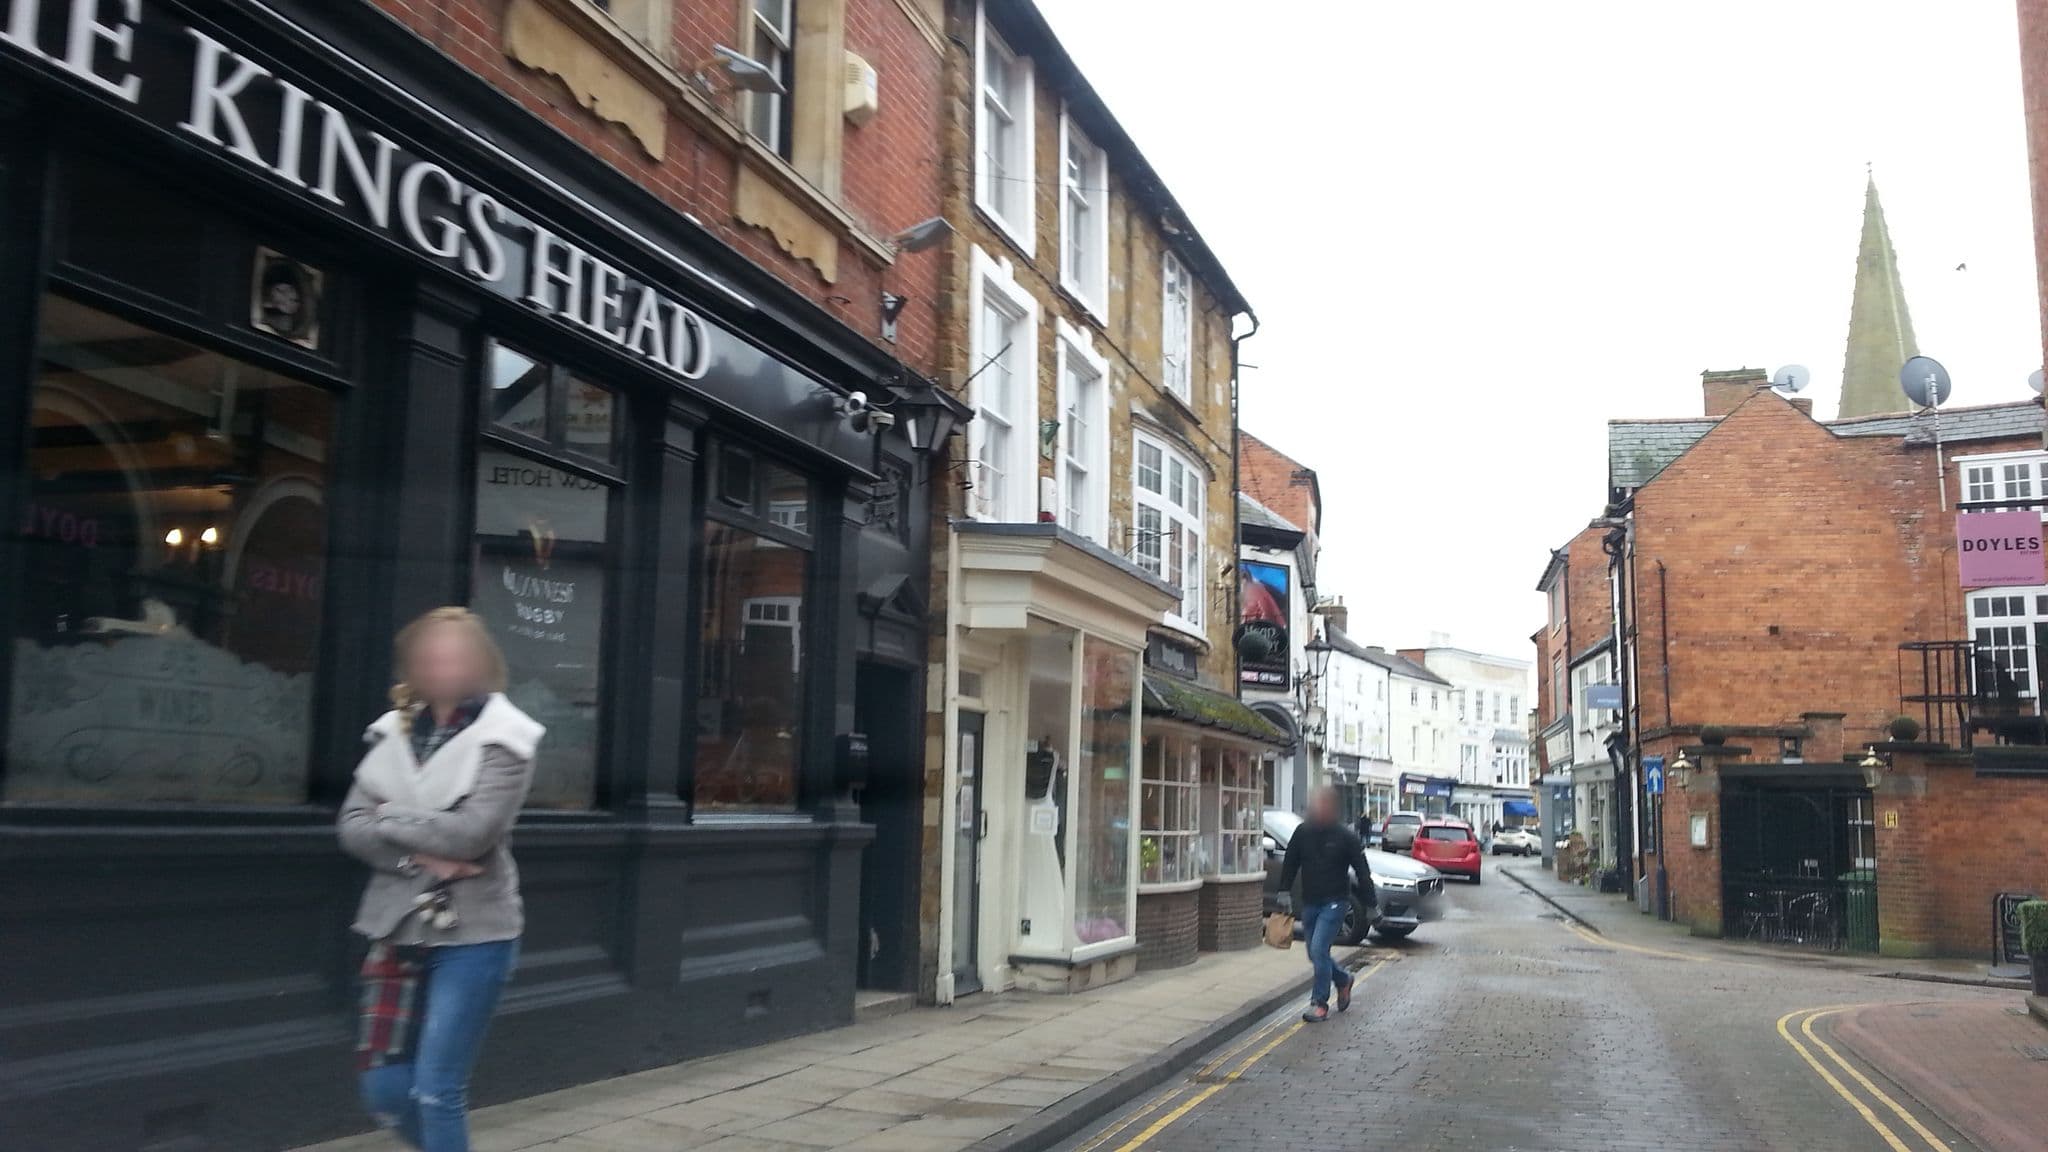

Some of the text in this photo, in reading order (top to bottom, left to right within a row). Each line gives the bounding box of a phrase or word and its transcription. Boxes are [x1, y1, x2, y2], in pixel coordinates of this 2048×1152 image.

[176, 26, 506, 282] KINGS
[523, 224, 711, 380] HEAD
[1962, 536, 2040, 552] DOYLES
